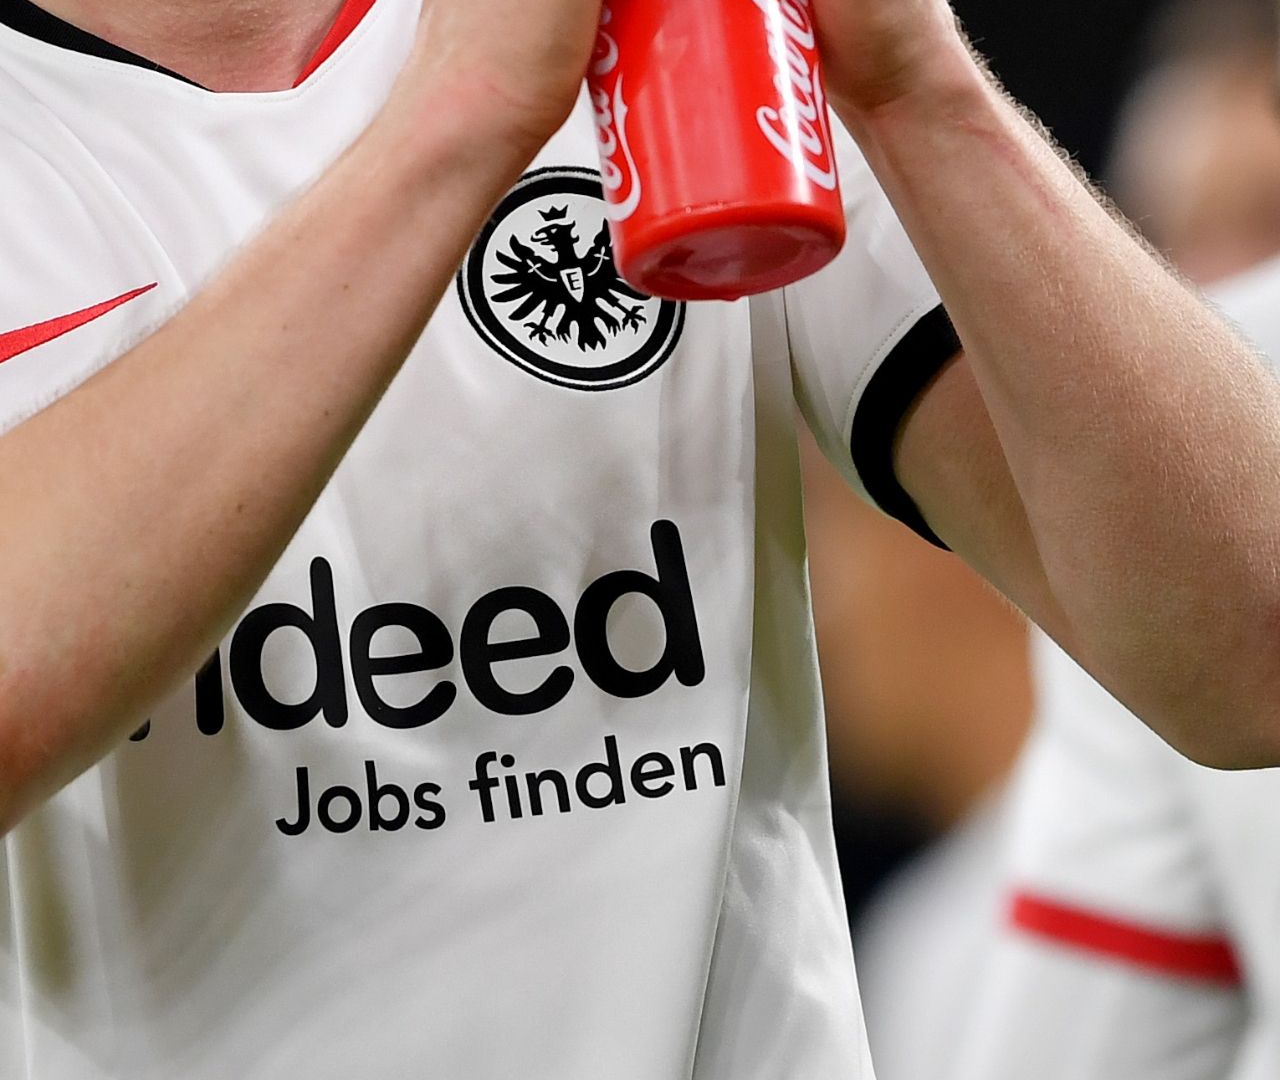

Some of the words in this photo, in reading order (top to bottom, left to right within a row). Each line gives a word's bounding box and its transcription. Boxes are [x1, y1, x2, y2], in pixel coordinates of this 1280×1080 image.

[128, 518, 706, 743] deed
[275, 759, 447, 836] Jobs
[468, 734, 726, 823] finden
